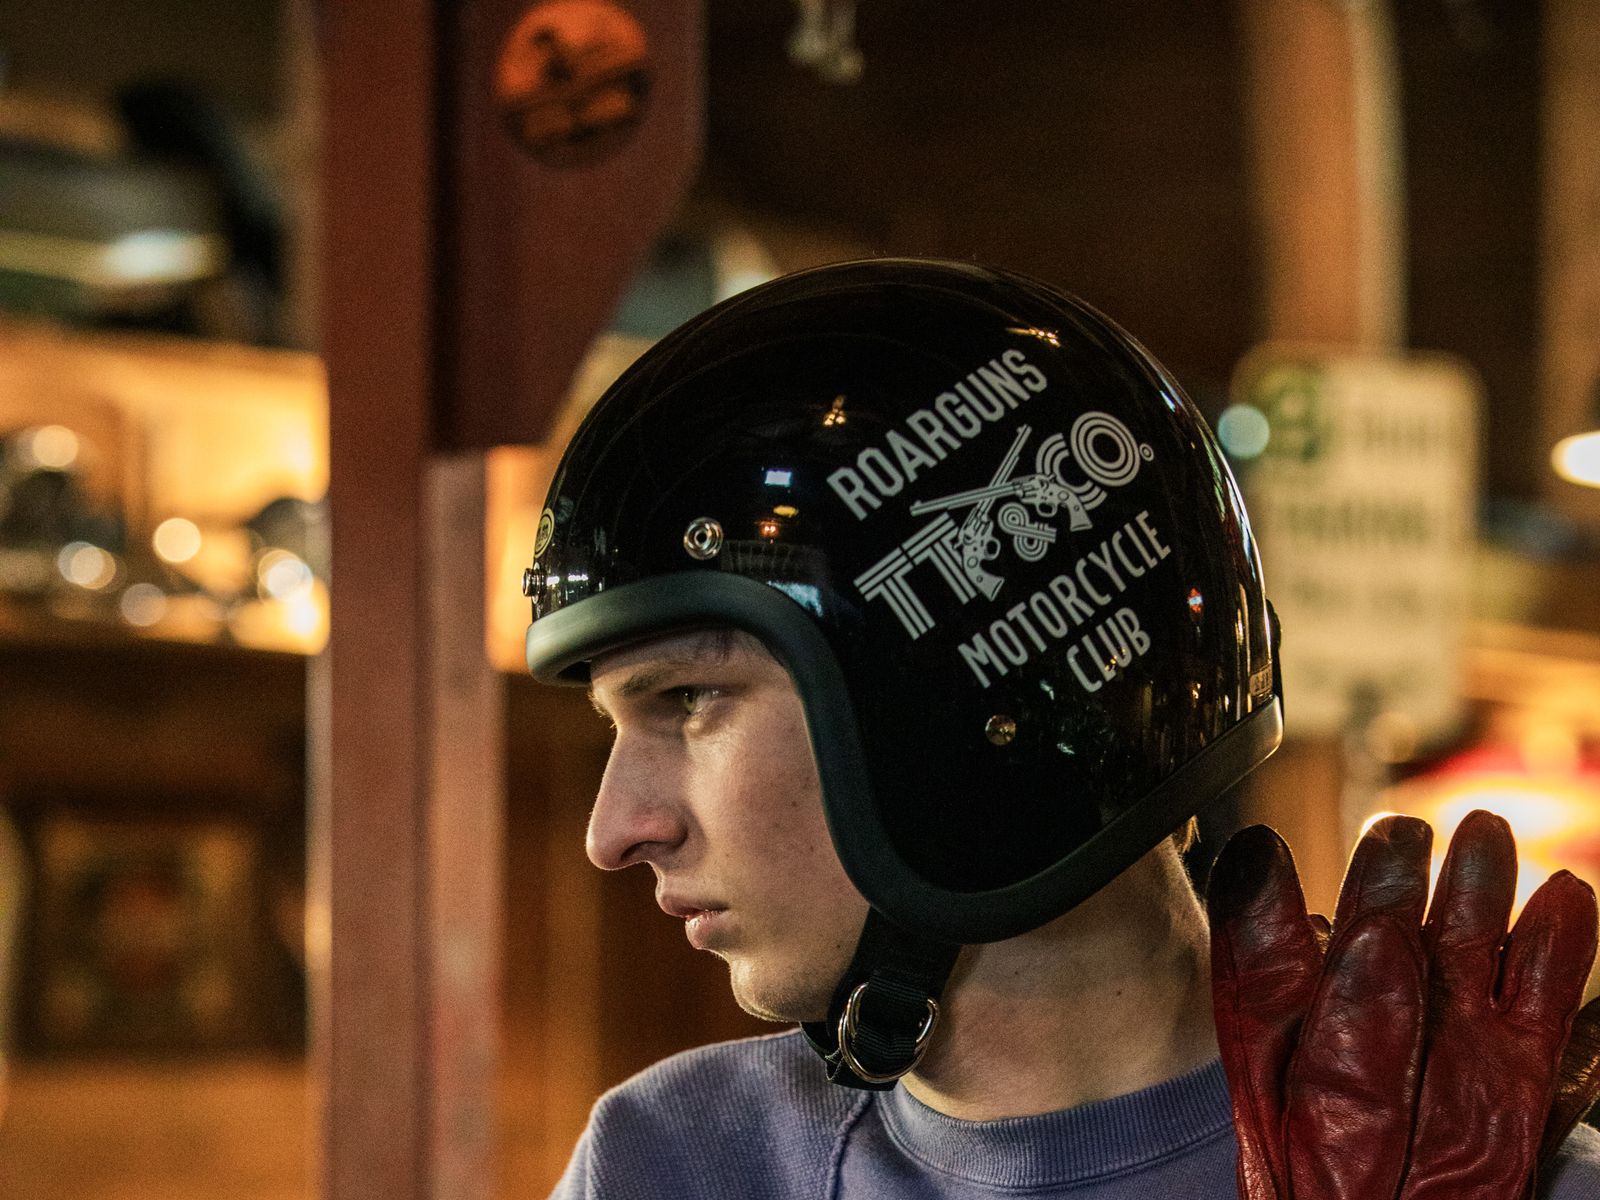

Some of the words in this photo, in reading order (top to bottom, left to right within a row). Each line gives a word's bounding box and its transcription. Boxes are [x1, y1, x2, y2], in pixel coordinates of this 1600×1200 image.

[826, 349, 1047, 521] ROARGUNS
[957, 510, 1171, 689] MOTORCYCLE
[1066, 607, 1151, 693] CLUB
